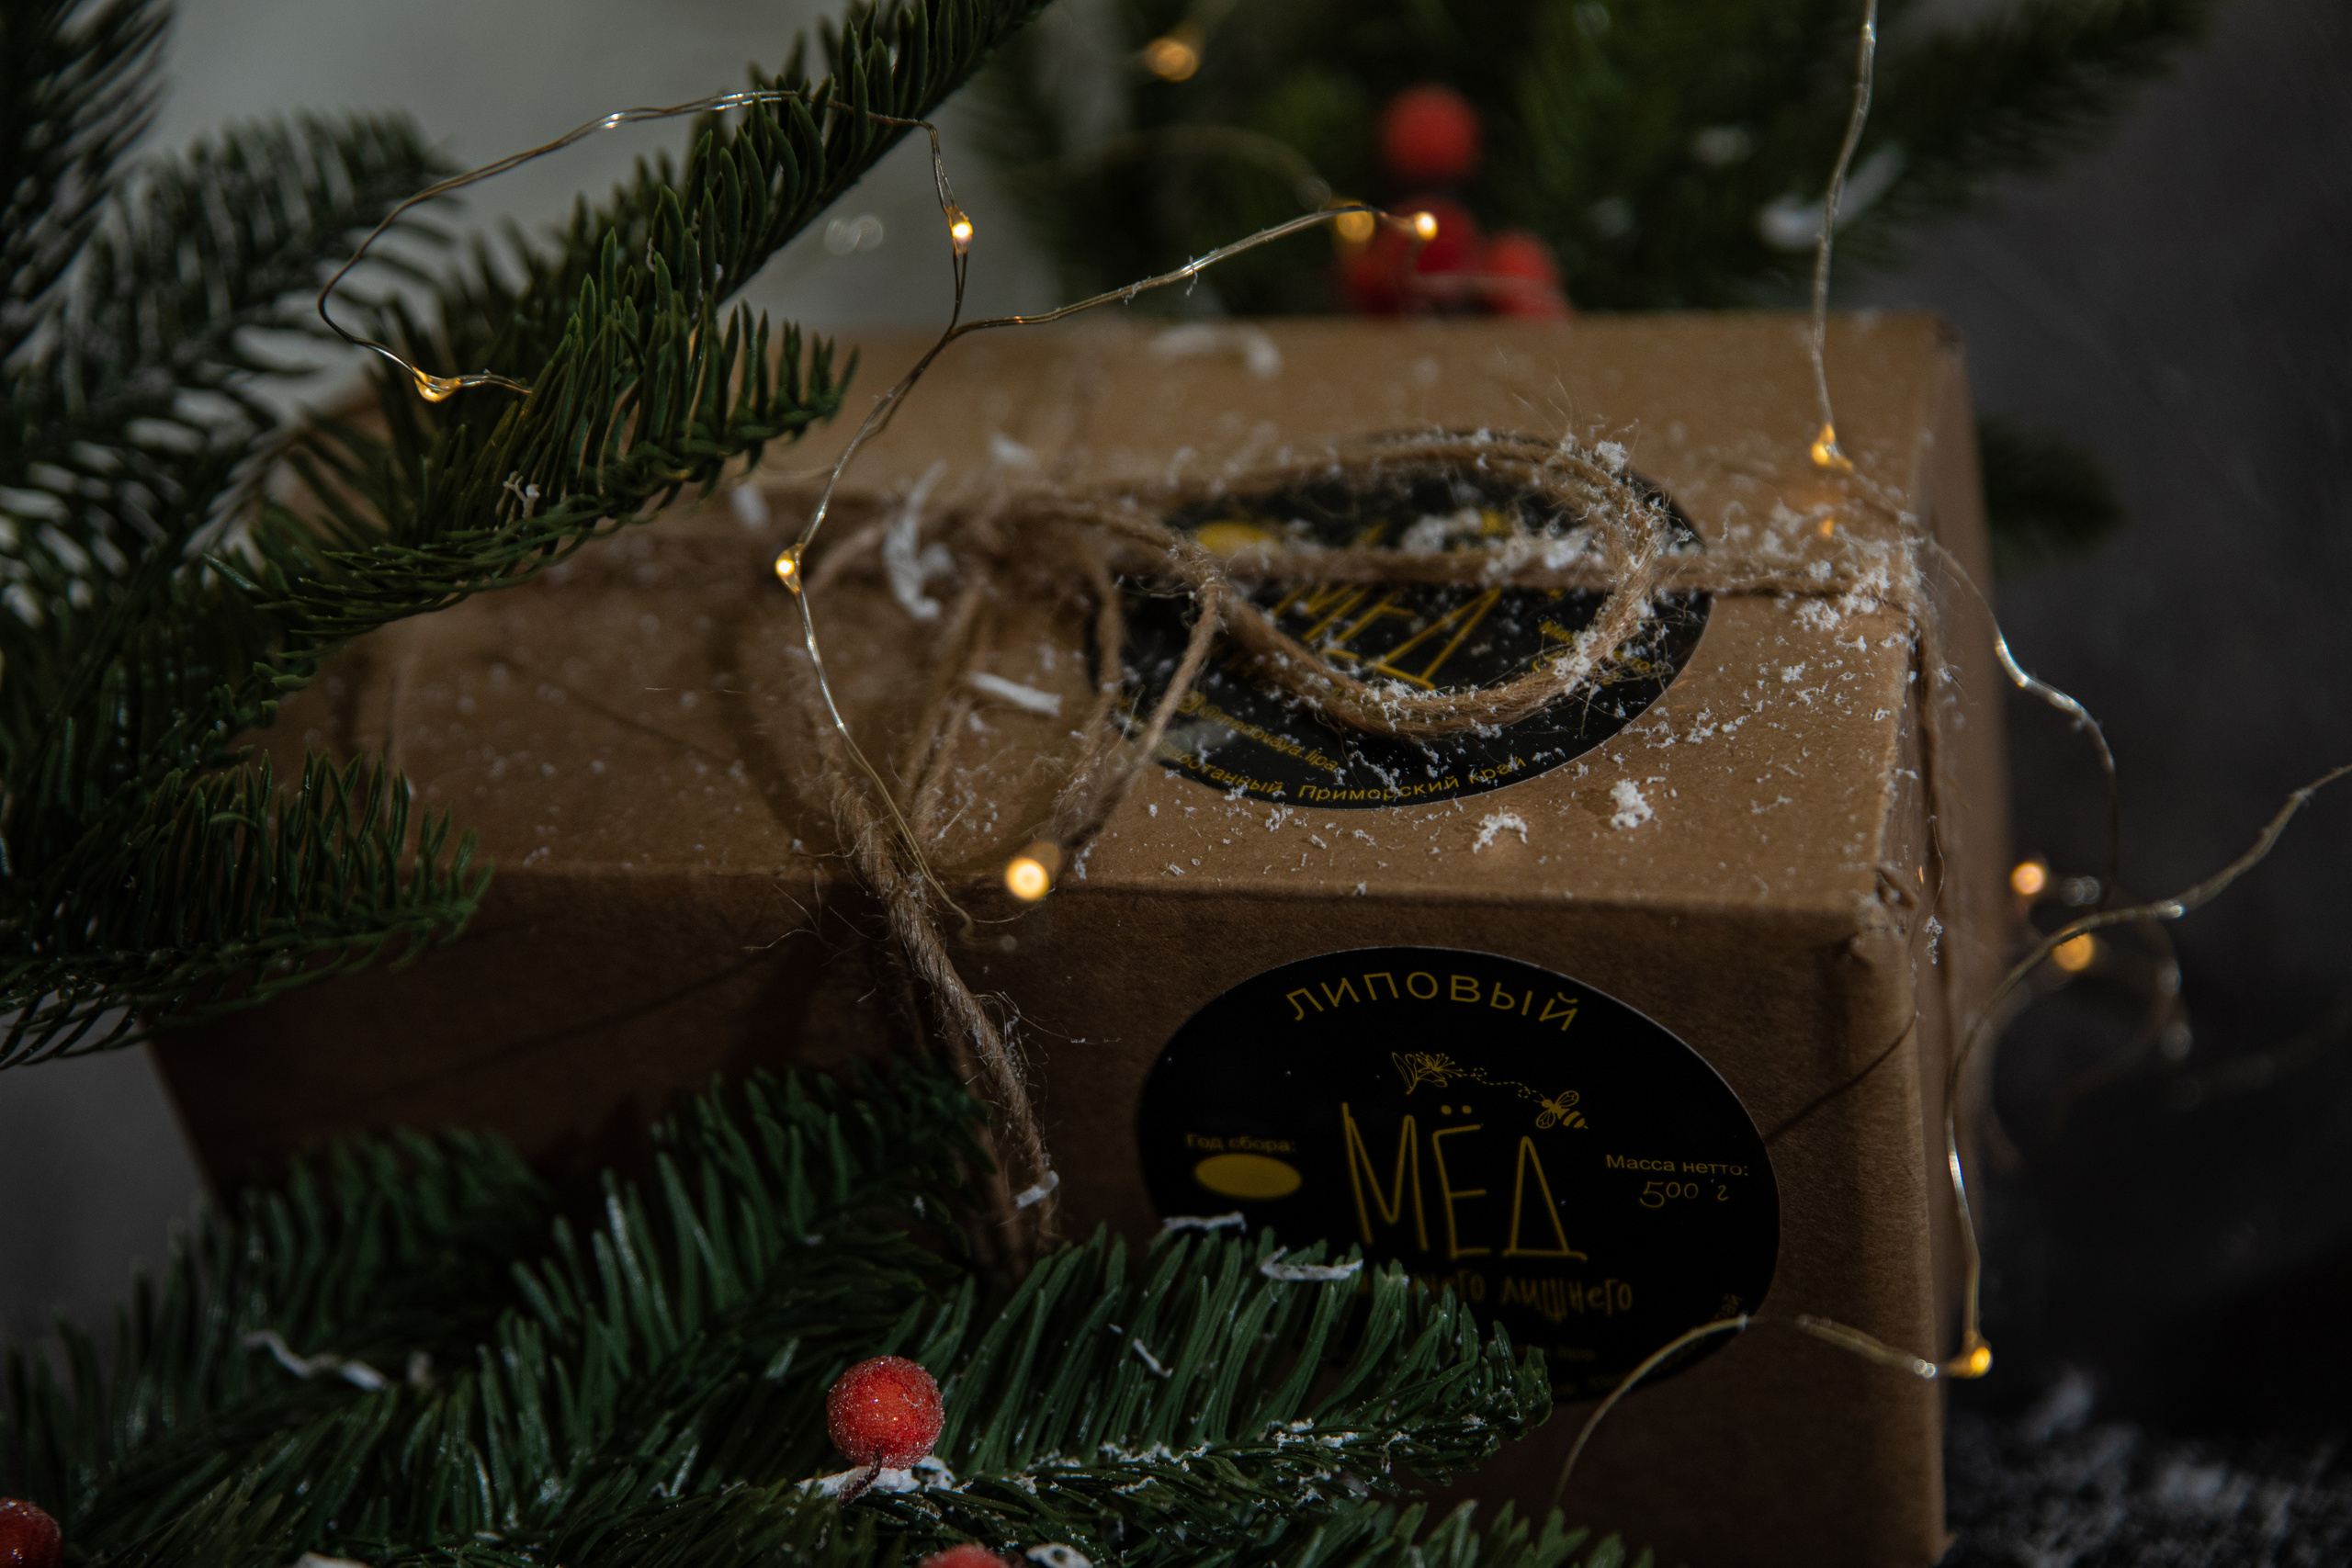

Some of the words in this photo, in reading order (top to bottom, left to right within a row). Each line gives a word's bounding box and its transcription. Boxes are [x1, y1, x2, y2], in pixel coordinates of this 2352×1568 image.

[1298, 775, 1460, 802] Приморский
[1285, 970, 1579, 1032] ЛИПОВЫЙ
[1185, 1132, 1224, 1150] Год
[1227, 1134, 1297, 1155] сбора:
[1604, 1153, 1676, 1172] Масса
[1681, 1161, 1749, 1178] нетто:
[1341, 1101, 1589, 1262] МЁД
[1638, 1179, 1699, 1209] 500
